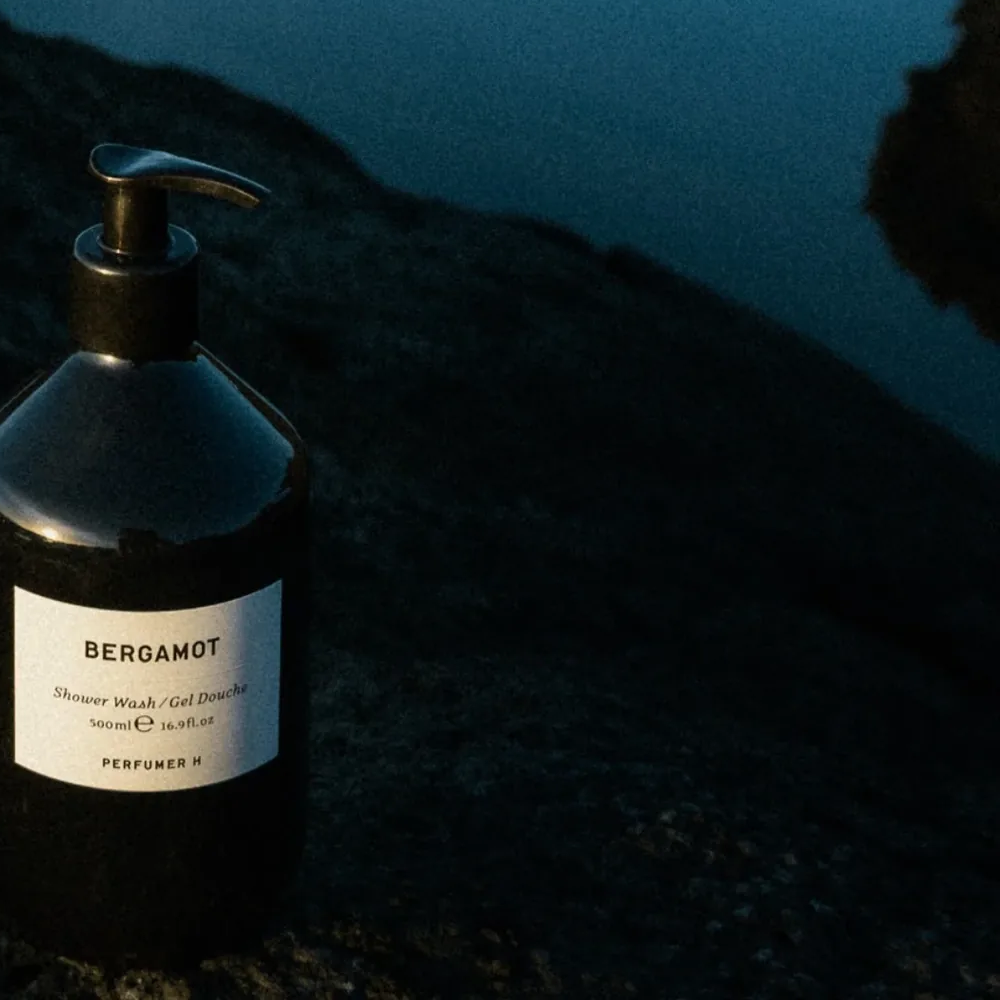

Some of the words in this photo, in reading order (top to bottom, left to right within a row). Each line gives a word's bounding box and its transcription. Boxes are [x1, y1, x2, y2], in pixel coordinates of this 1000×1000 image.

[84, 636, 221, 664] BERGAMOT
[53, 686, 109, 708] Shower
[113, 696, 156, 710] Wash
[169, 694, 194, 708] Gel
[197, 683, 249, 706] Douche
[89, 718, 132, 731] 500ml
[102, 757, 186, 771] PERFUMER
[192, 755, 202, 767] H
